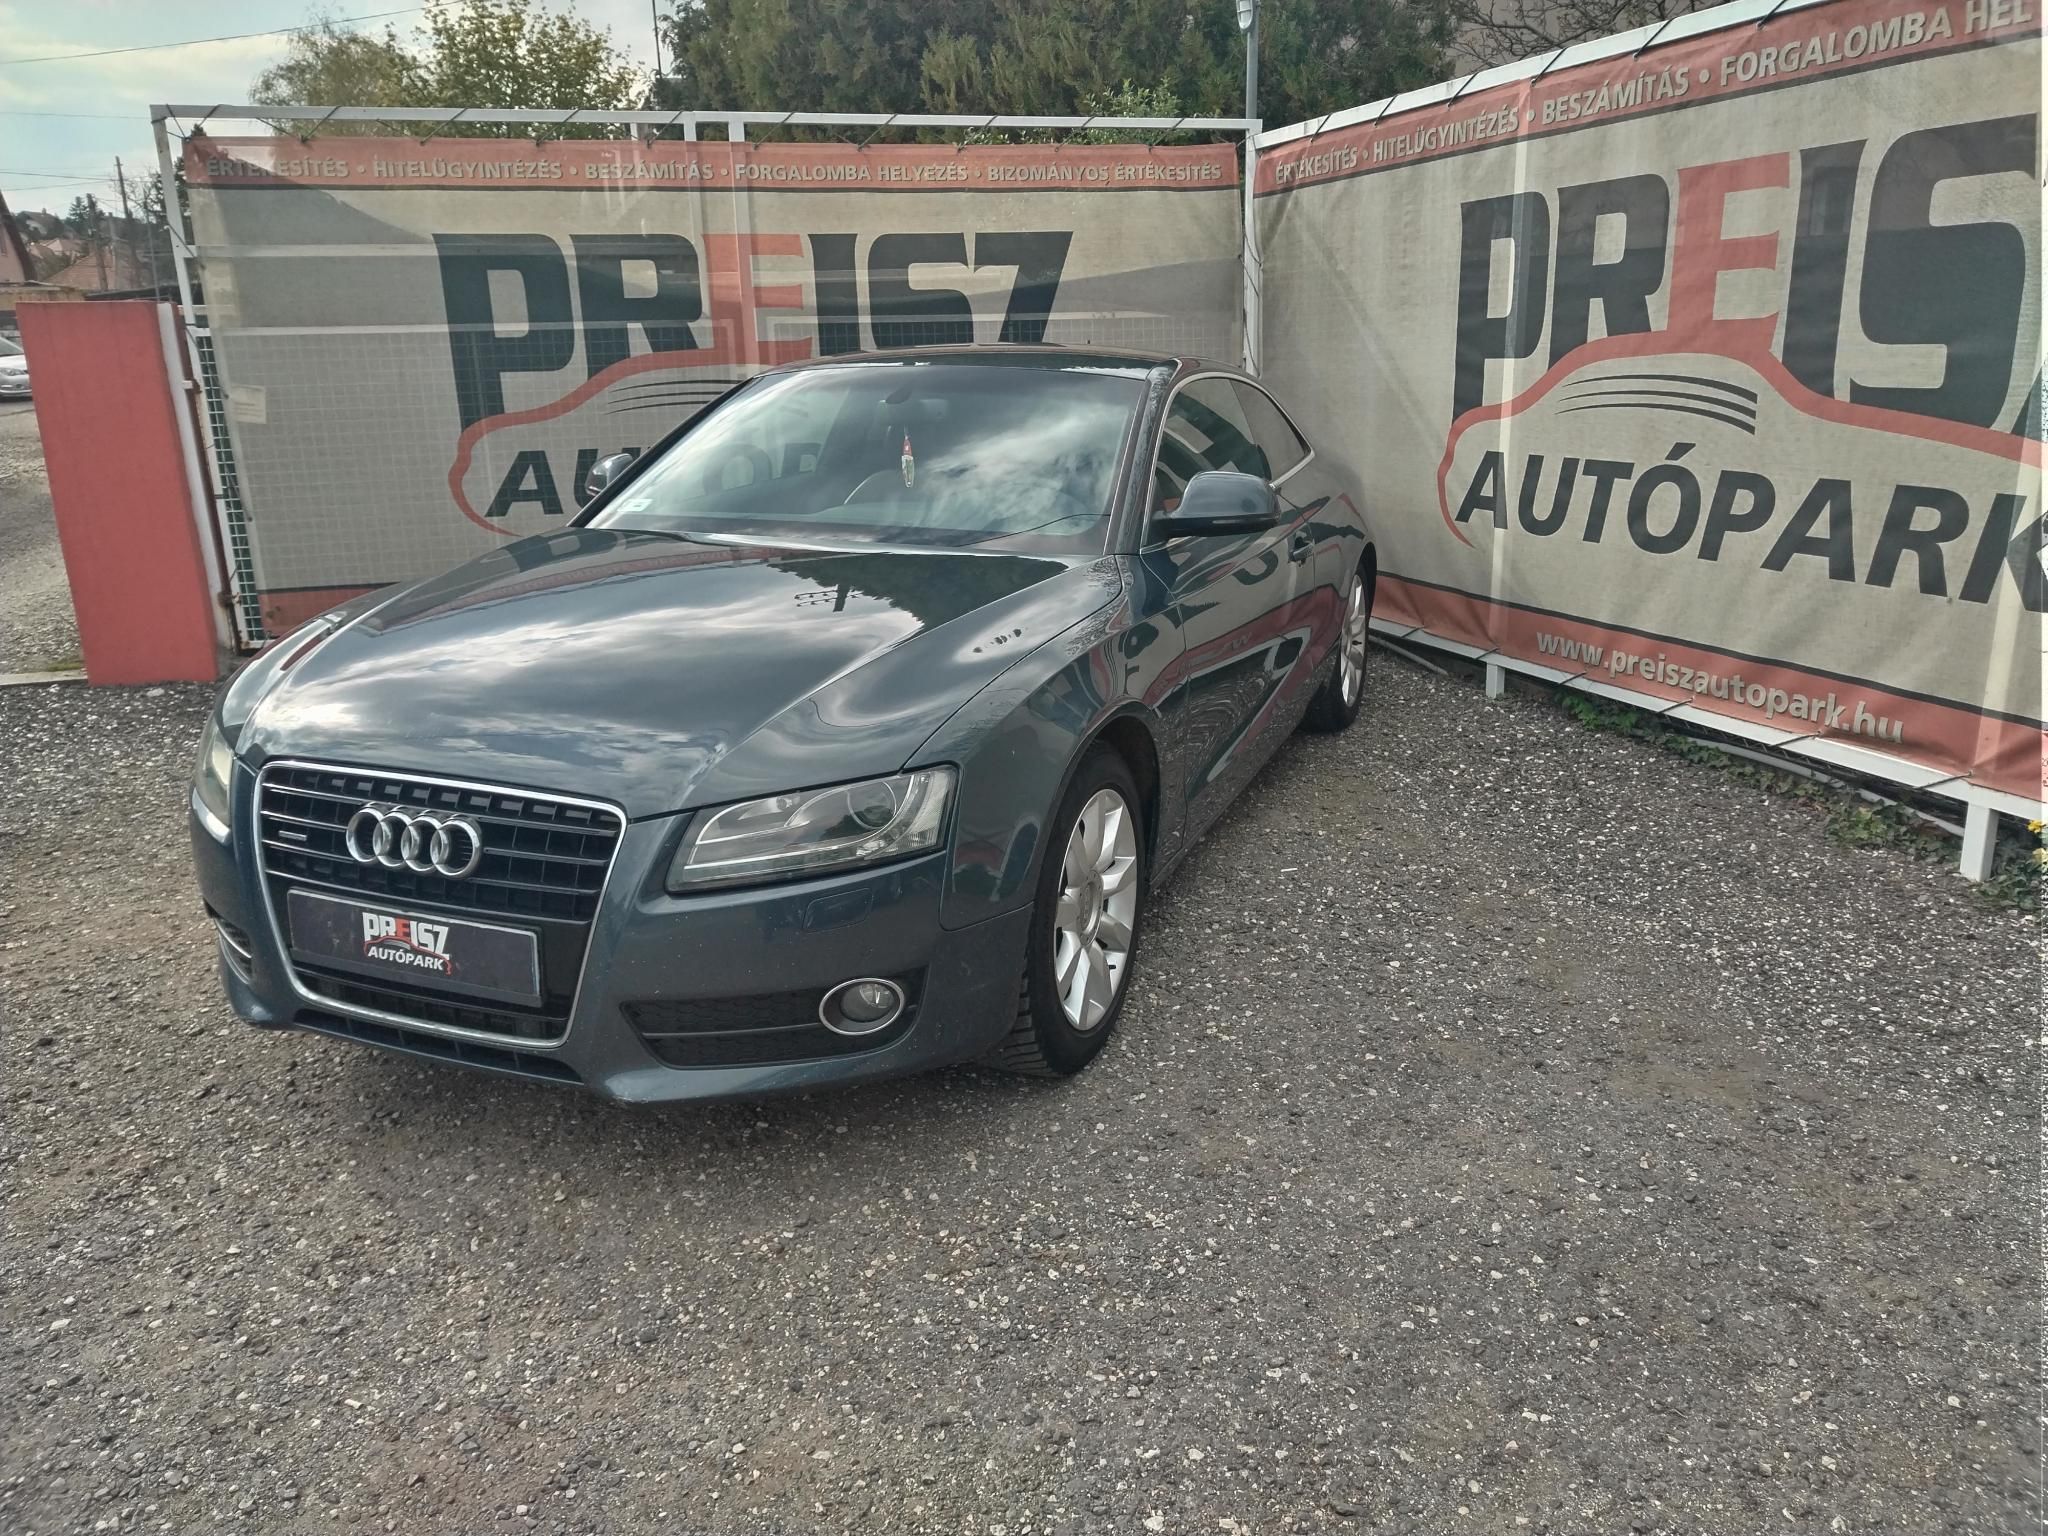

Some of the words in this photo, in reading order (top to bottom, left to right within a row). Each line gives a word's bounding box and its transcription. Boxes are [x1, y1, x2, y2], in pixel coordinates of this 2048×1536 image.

[1373, 106, 1520, 163] HITELÜGYINTÉZÉS
[1542, 64, 1690, 125] BESZÁMÍTÁS
[1720, 7, 1954, 87] FORGALOMBA
[373, 157, 563, 180] HITELÜGYINTÉZÉS
[585, 159, 714, 180] BESZÁMÍTÁS
[735, 163, 873, 181] FORGALOMBA
[878, 162, 969, 182] HELYEZÉS
[987, 161, 1110, 182] BIZOMÁNYOS
[1115, 162, 1222, 181] ÉRTÉKESÍTÉS
[1452, 113, 2045, 432] PREIS
[1455, 442, 2047, 613] AUTÓPARK
[1536, 632, 1904, 744] www.preiszautopark.hu
[367, 946, 444, 970] AUTÓPARK
